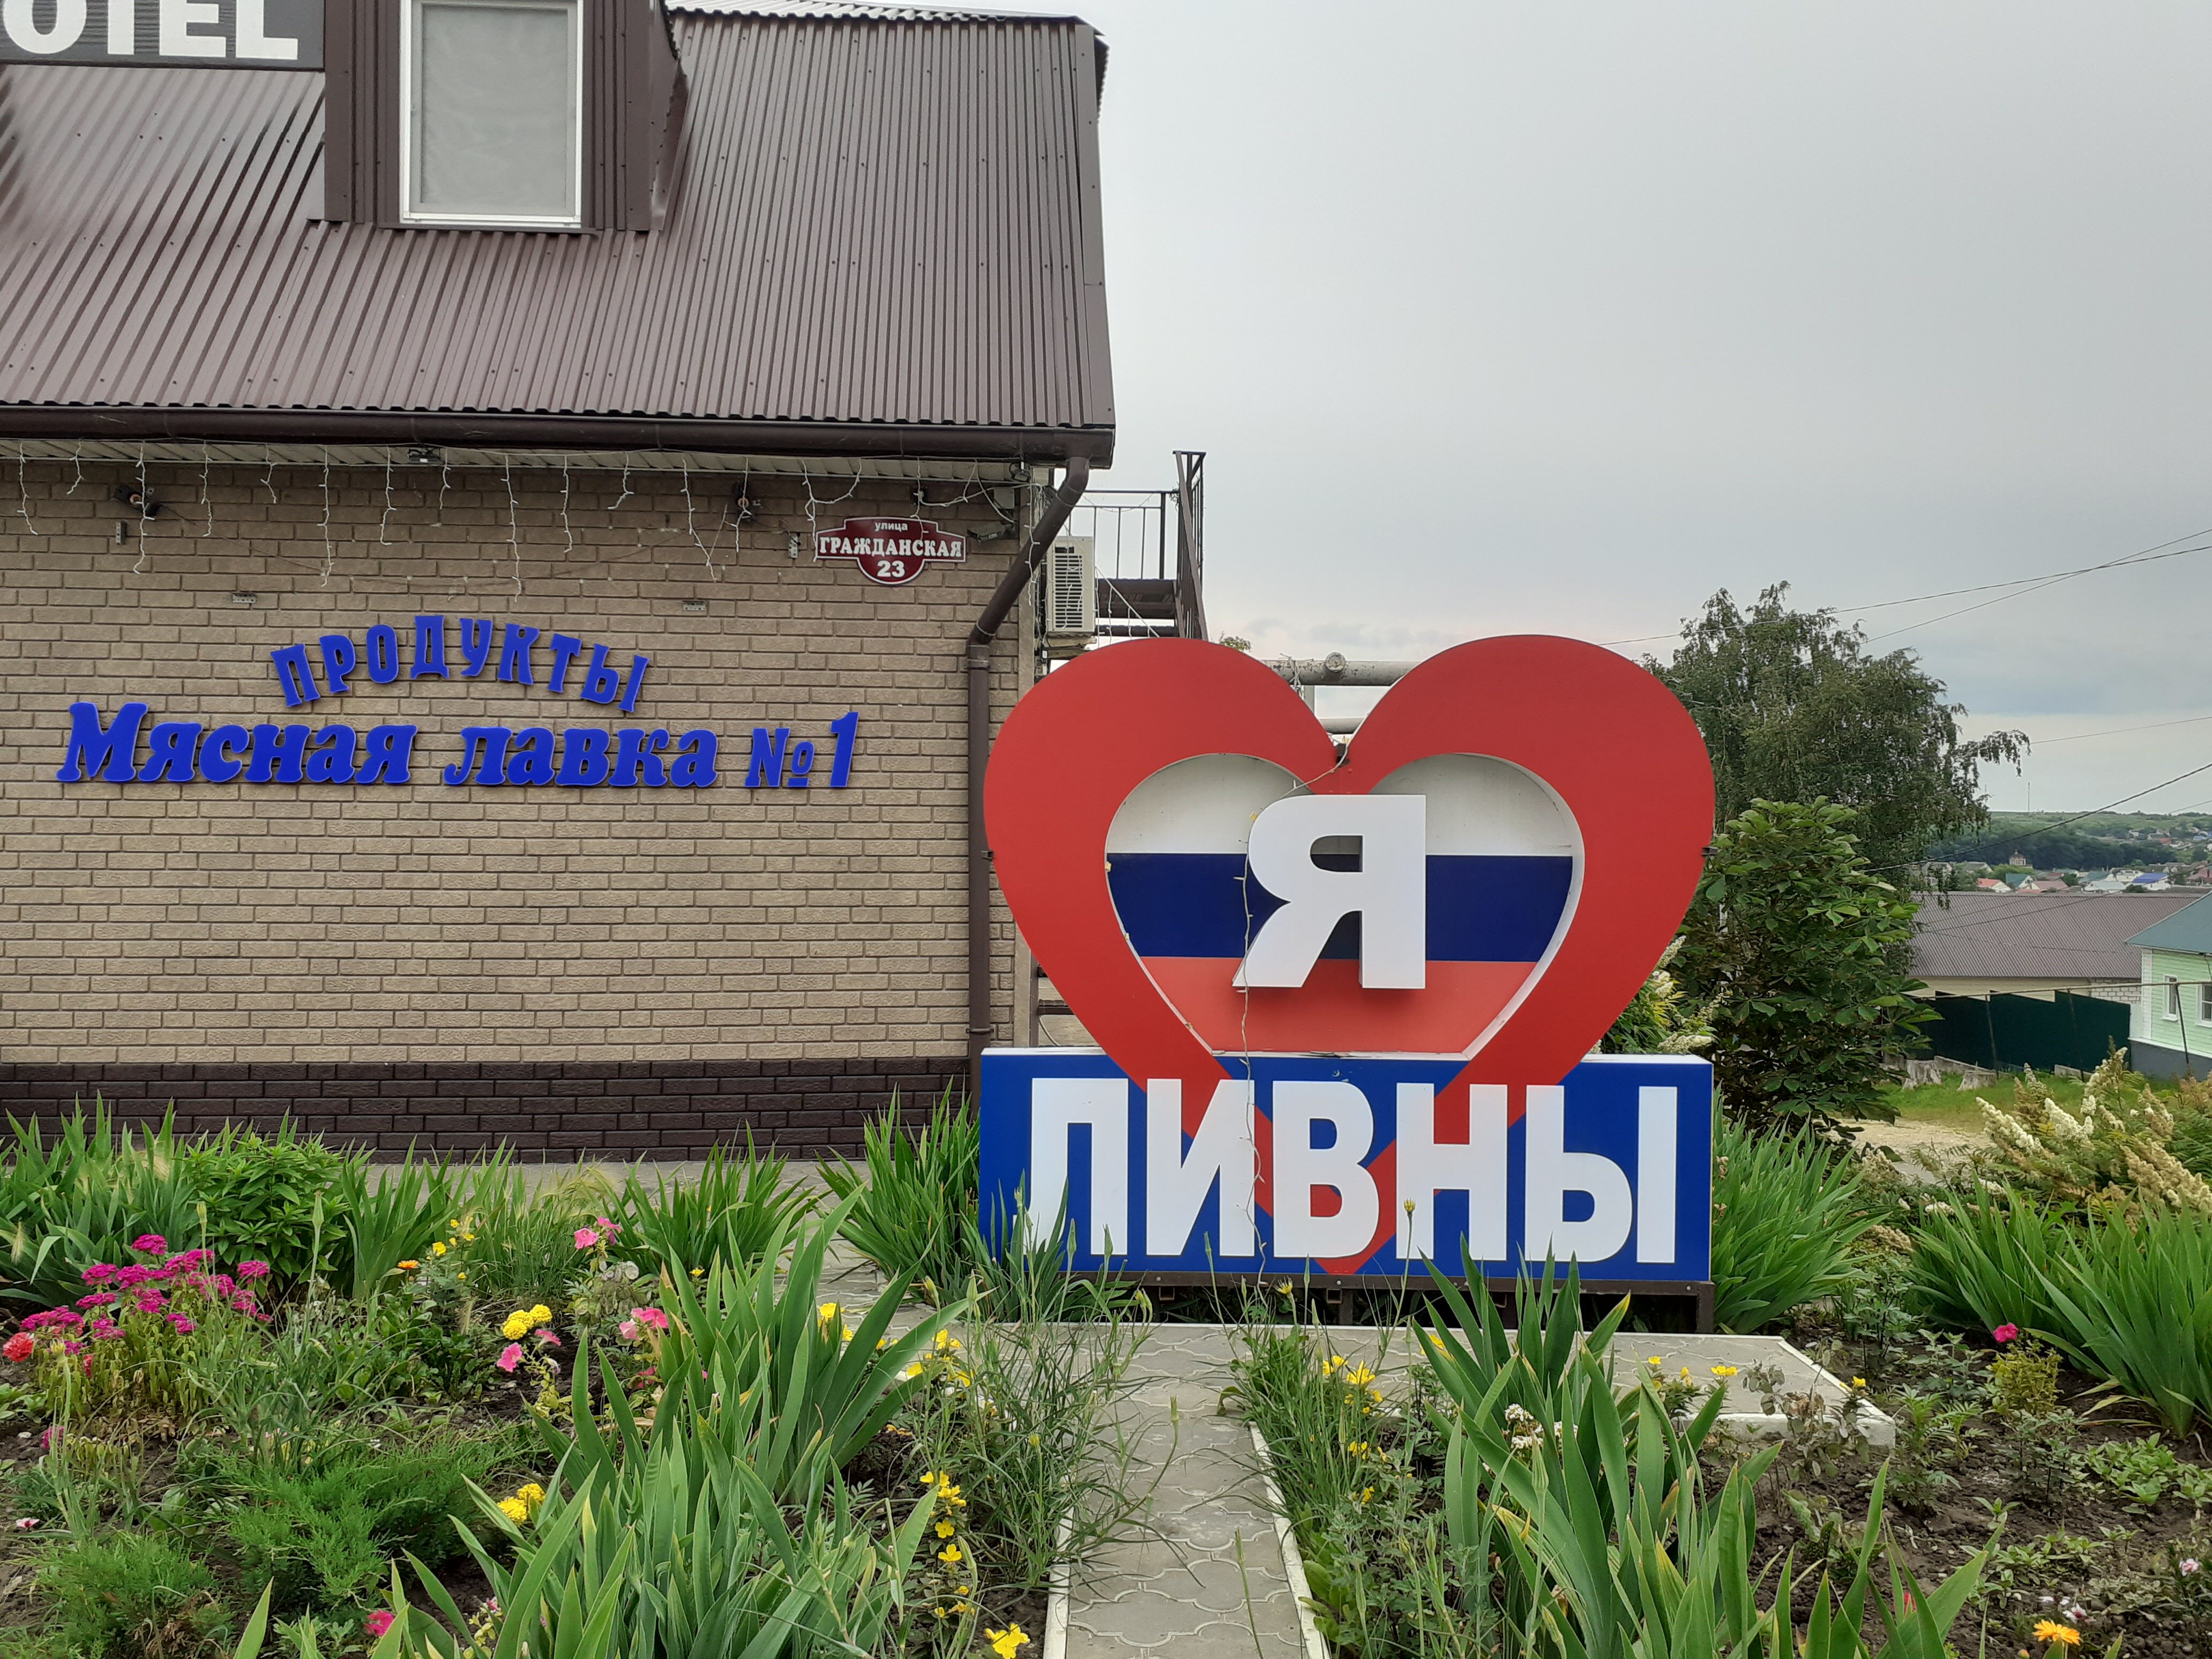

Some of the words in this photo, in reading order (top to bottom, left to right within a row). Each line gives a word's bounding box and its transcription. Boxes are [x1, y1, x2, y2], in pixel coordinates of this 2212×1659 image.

[819, 536, 962, 558] ГРАЖДАНСКАЯ
[875, 521, 908, 533] улица
[877, 560, 906, 578] 23
[271, 615, 649, 712] ПРОДУКТЫ
[56, 703, 417, 784] Мясная
[444, 727, 717, 788] лавка
[1232, 794, 1426, 989] Я
[1013, 1077, 1678, 1263] ЛИВНЫ
